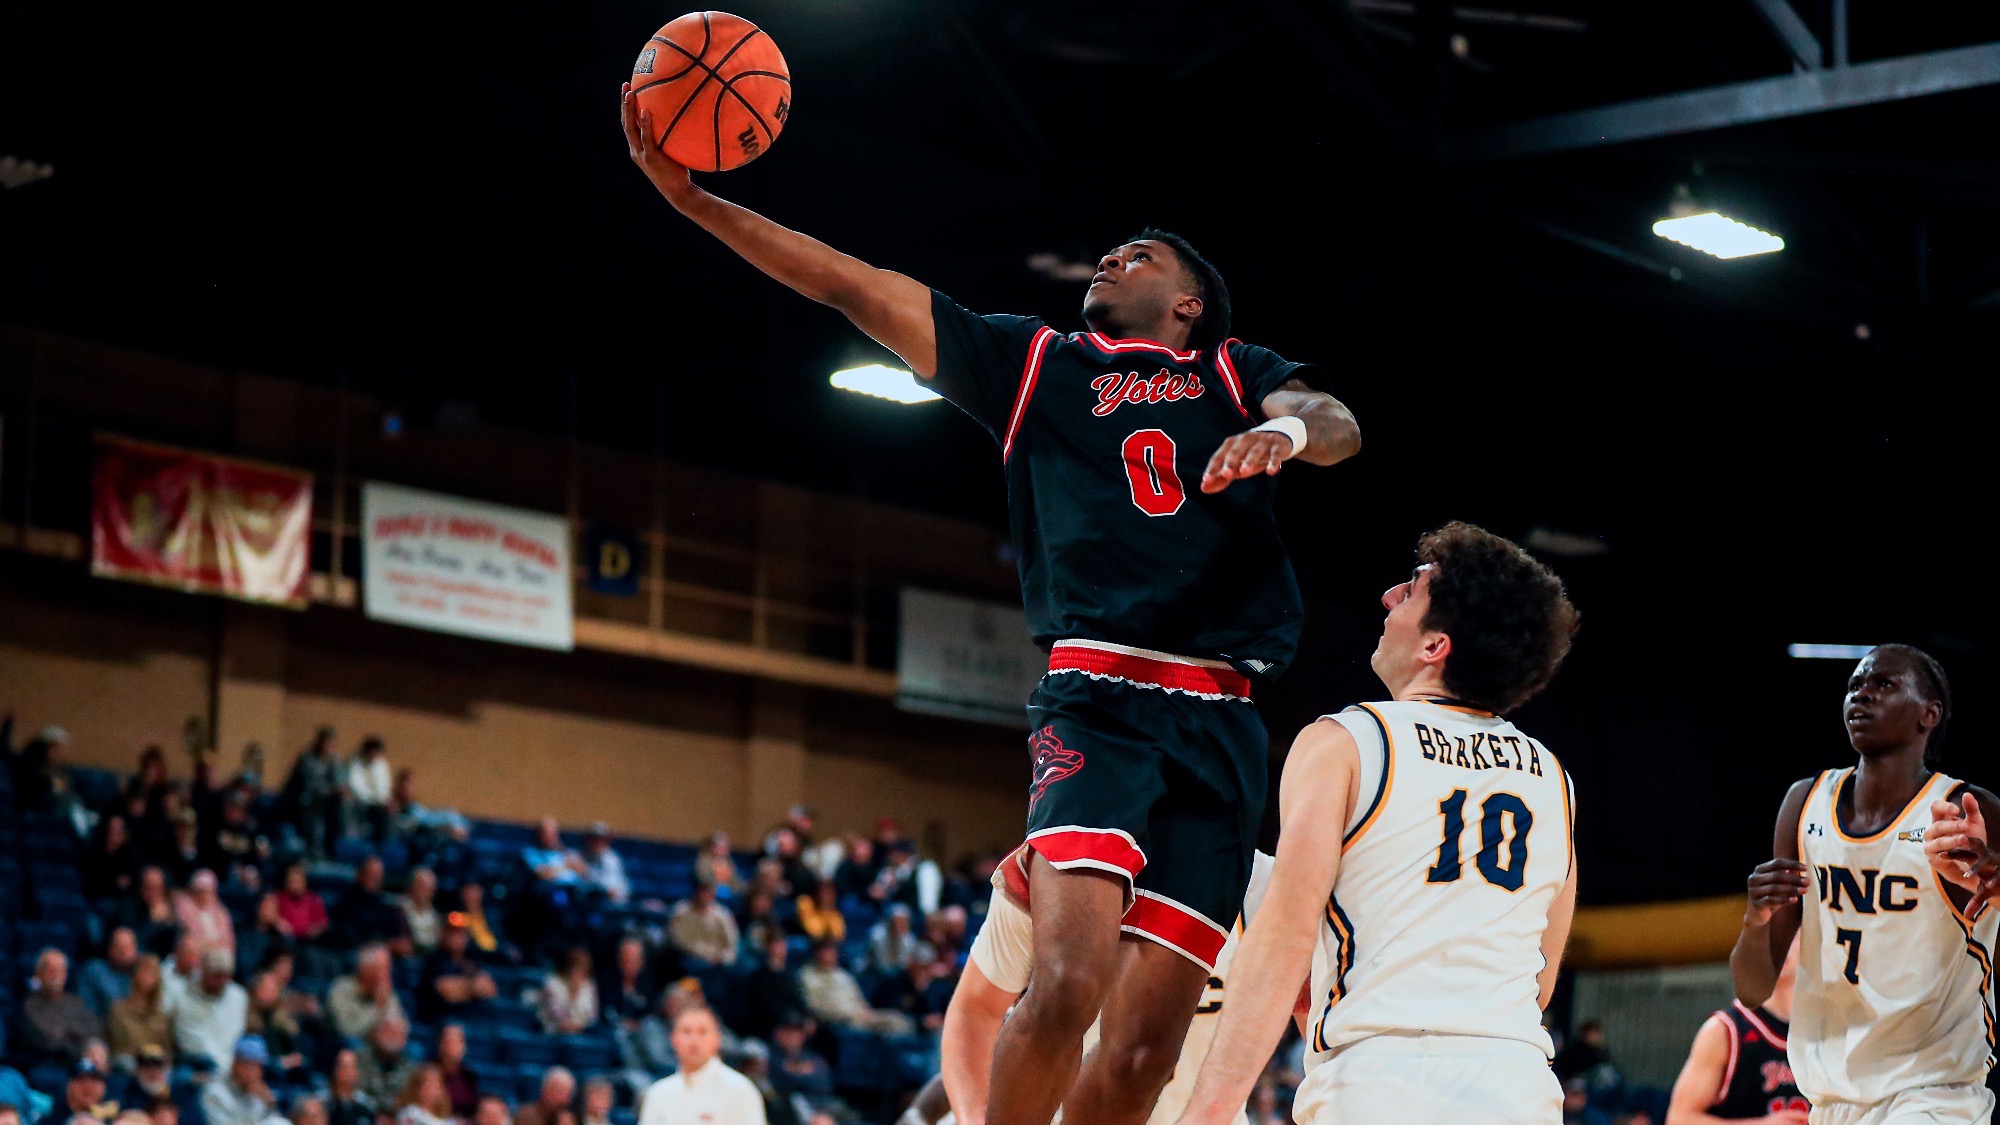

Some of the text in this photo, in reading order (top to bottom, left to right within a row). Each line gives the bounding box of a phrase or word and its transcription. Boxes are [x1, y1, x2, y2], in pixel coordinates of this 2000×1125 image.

[1091, 368, 1205, 416] Yotes
[1121, 429, 1186, 517] 0
[1414, 722, 1543, 777] BRAKETA
[1424, 786, 1535, 894] 10
[1836, 926, 1862, 985] 7
